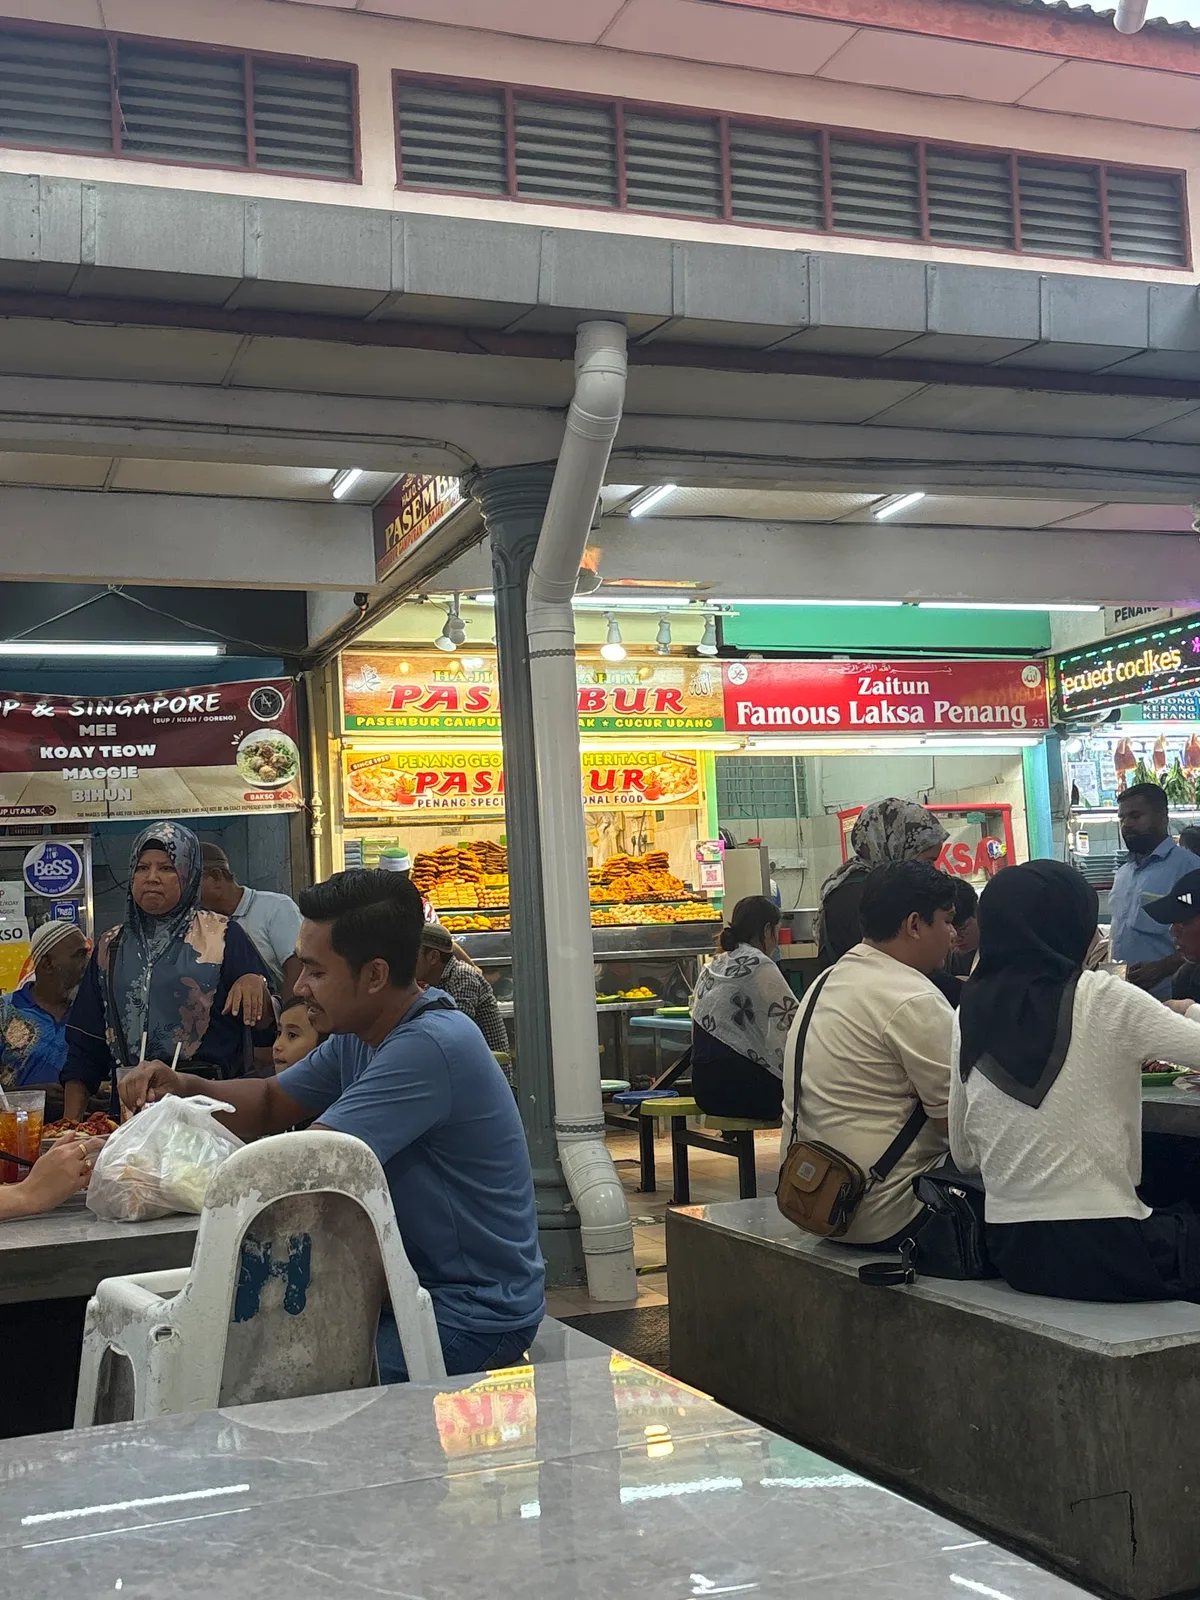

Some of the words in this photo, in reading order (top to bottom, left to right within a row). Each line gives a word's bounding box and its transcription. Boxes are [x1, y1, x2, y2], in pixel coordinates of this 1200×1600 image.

[433, 669, 492, 683] HAJI
[578, 671, 642, 685] AHIM
[857, 676, 930, 695] Zaitun
[0, 699, 20, 717] P
[31, 700, 56, 717] &
[67, 693, 222, 718] SINGAPORE
[386, 684, 688, 713] PASBUR
[736, 701, 841, 725] Famous
[849, 700, 926, 725] Laksa
[933, 700, 1028, 728] Penang
[357, 716, 440, 727] PASEMBUR
[444, 717, 501, 728] CAMPU
[615, 718, 662, 728] CUCUR
[666, 719, 713, 728] UDANG
[1031, 718, 1045, 727] 23
[79, 724, 117, 736] MEE
[40, 746, 95, 759] KOAY
[99, 744, 156, 758] TEOW
[353, 760, 373, 770] SINCE
[398, 755, 465, 768] PENANG
[583, 753, 658, 765] HERITAGE
[62, 766, 139, 780] MAGGIE
[72, 788, 132, 802] BIHUN
[418, 798, 467, 807] PENANG
[470, 797, 505, 807] SPECI
[615, 795, 643, 803] FOOD
[934, 841, 995, 876] KSA
[34, 859, 73, 876] BeSS
